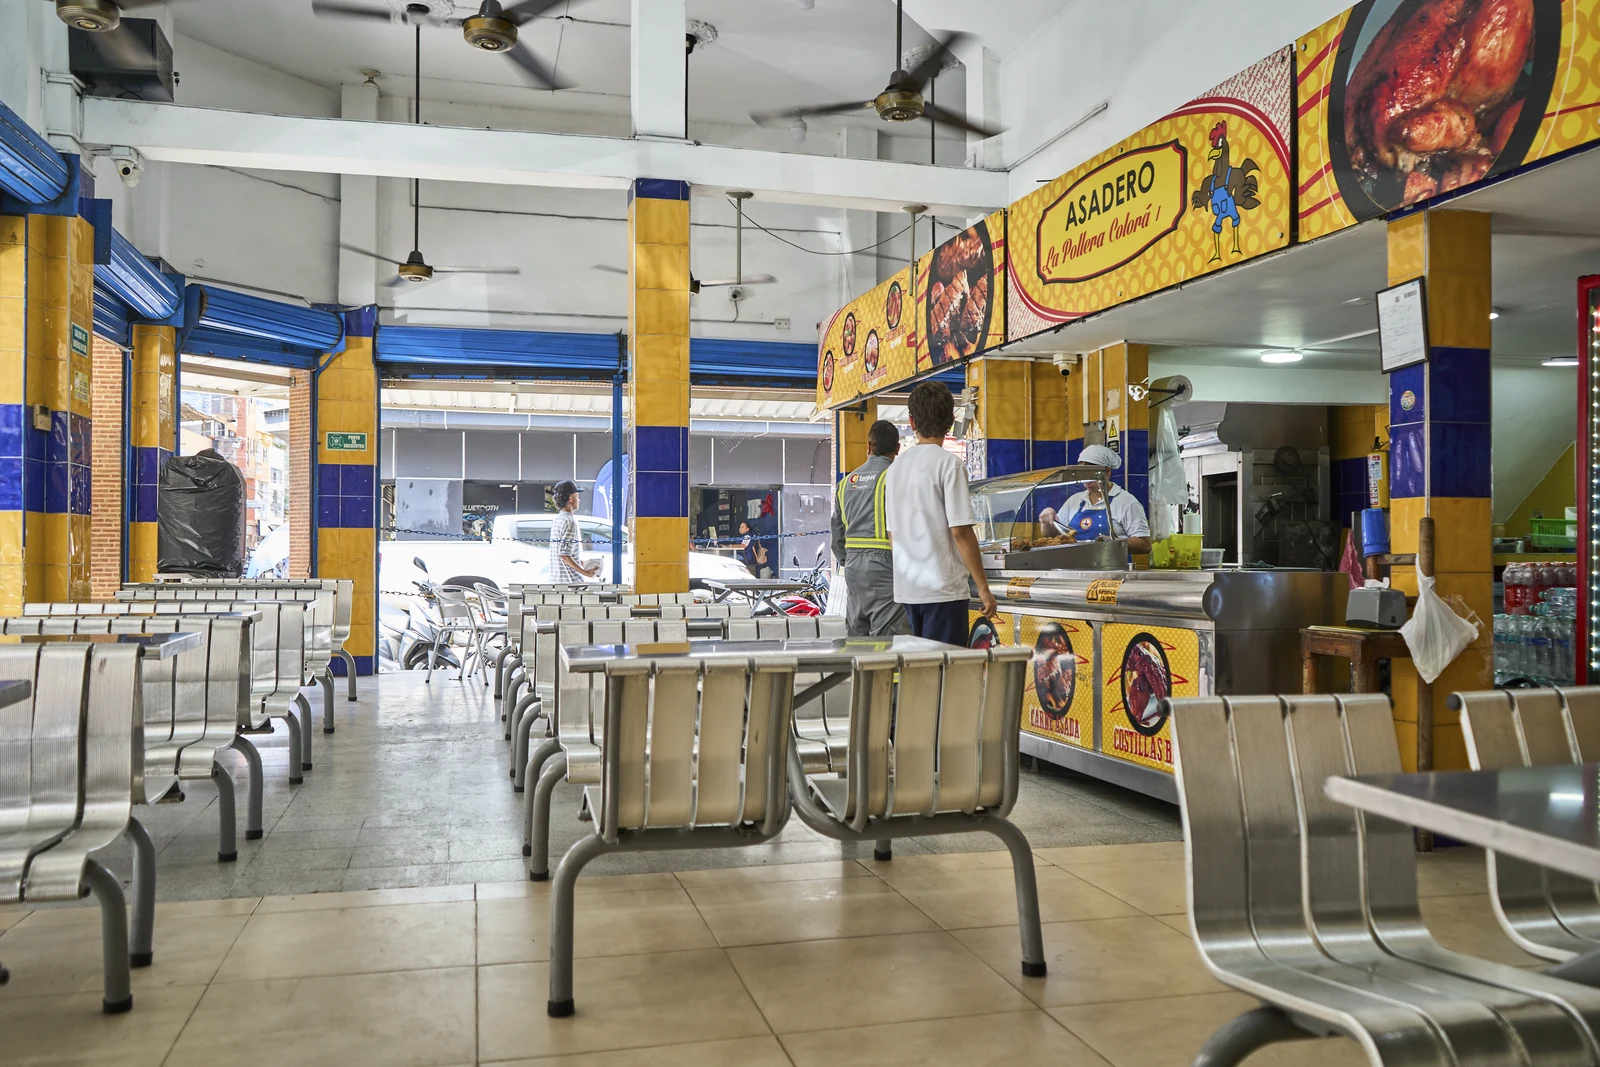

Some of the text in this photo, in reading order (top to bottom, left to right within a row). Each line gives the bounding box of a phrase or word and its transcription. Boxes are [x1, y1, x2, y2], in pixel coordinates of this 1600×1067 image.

[1065, 160, 1155, 231] ASADERO
[1042, 245, 1060, 275] La
[1062, 231, 1105, 264] Pollera
[1109, 203, 1152, 243] Colorá
[1030, 709, 1080, 739] CARNE ASADA
[1113, 727, 1163, 762] COSTILLAS
